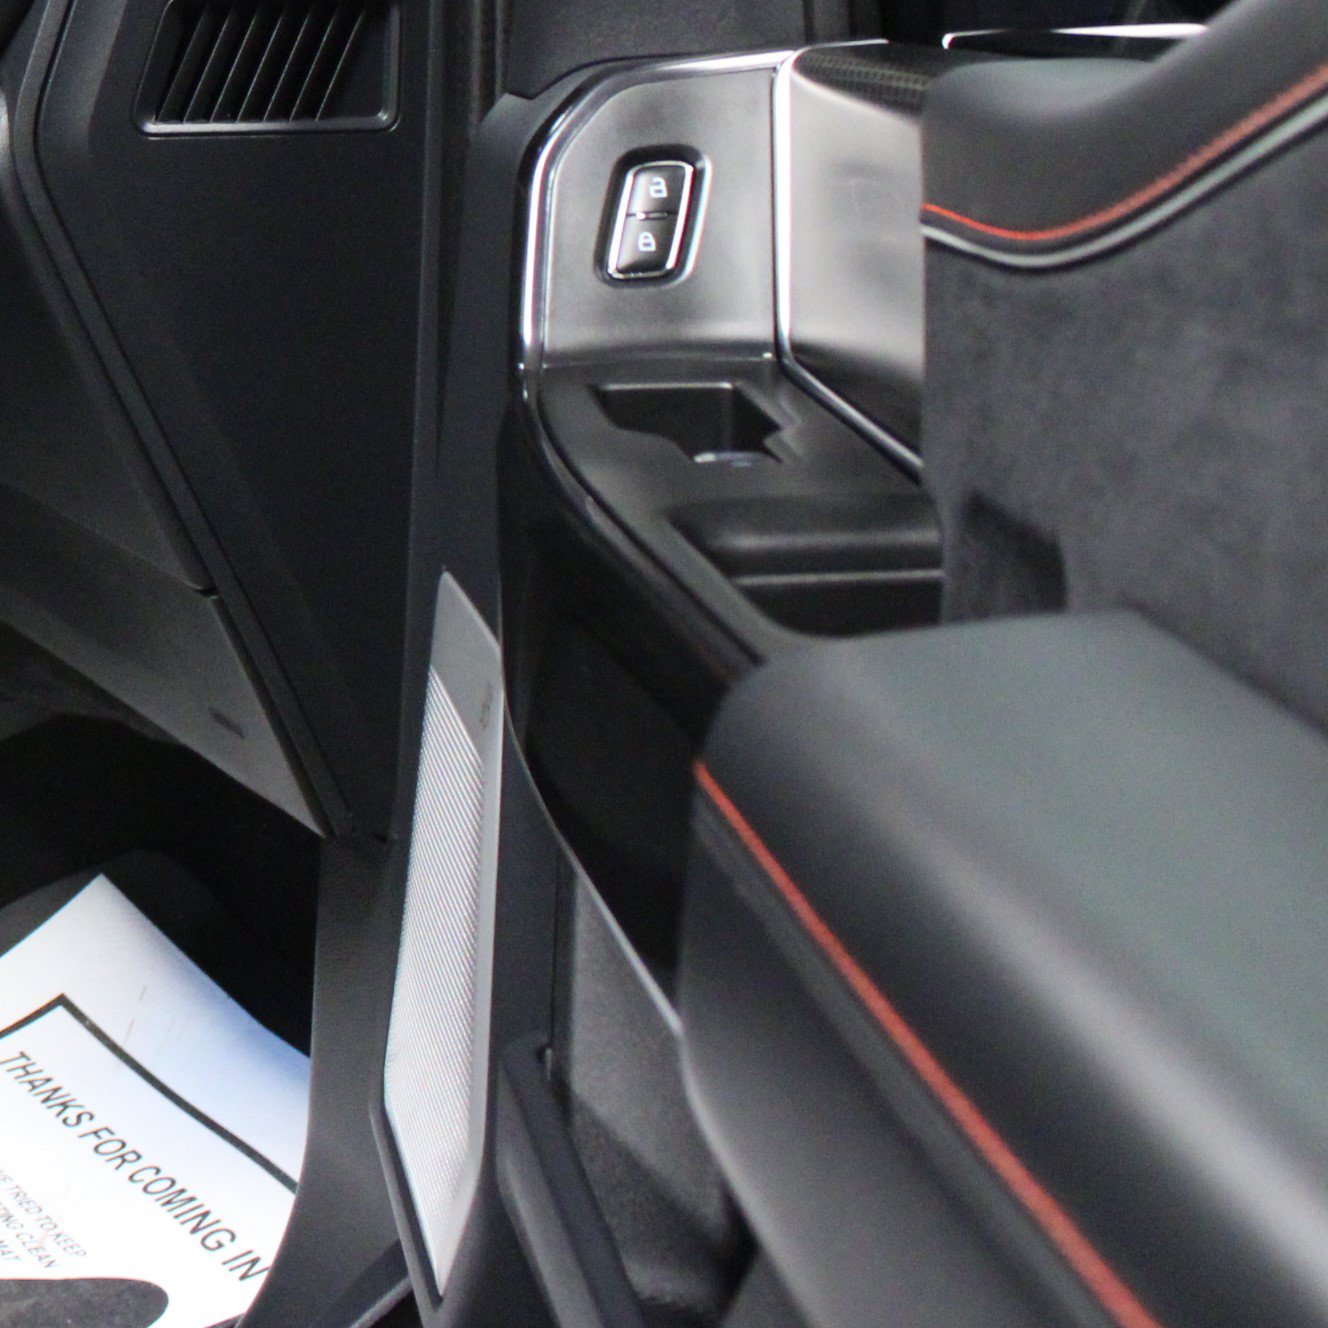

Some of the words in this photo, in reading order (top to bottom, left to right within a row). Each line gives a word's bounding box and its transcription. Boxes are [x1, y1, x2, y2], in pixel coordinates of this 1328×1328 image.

[6, 1185, 43, 1215] TRIED
[37, 1215, 58, 1231] TO
[49, 1231, 87, 1257] KEEP
[78, 1126, 142, 1170] FOR
[128, 1165, 236, 1252] COMING
[221, 1249, 272, 1281] IN
[16, 1232, 60, 1269] CLEAN
